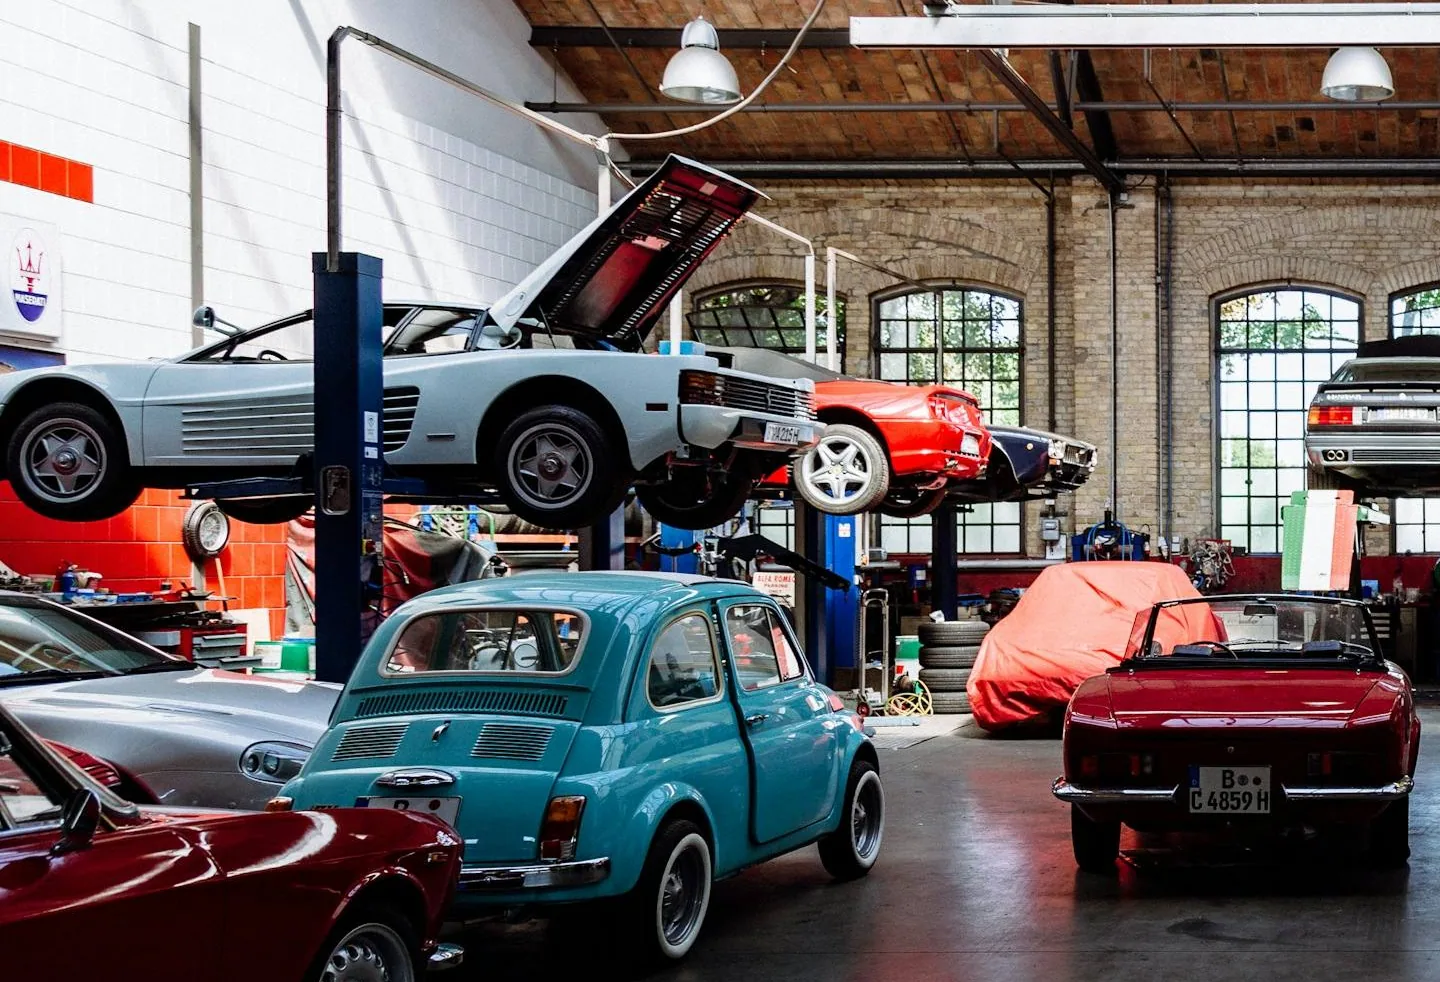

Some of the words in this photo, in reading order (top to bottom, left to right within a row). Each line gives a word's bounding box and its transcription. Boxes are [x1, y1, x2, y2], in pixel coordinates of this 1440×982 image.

[1222, 769, 1235, 789] B
[1191, 791, 1203, 810] C
[1207, 791, 1253, 811] 4859
[1256, 791, 1269, 811] H
